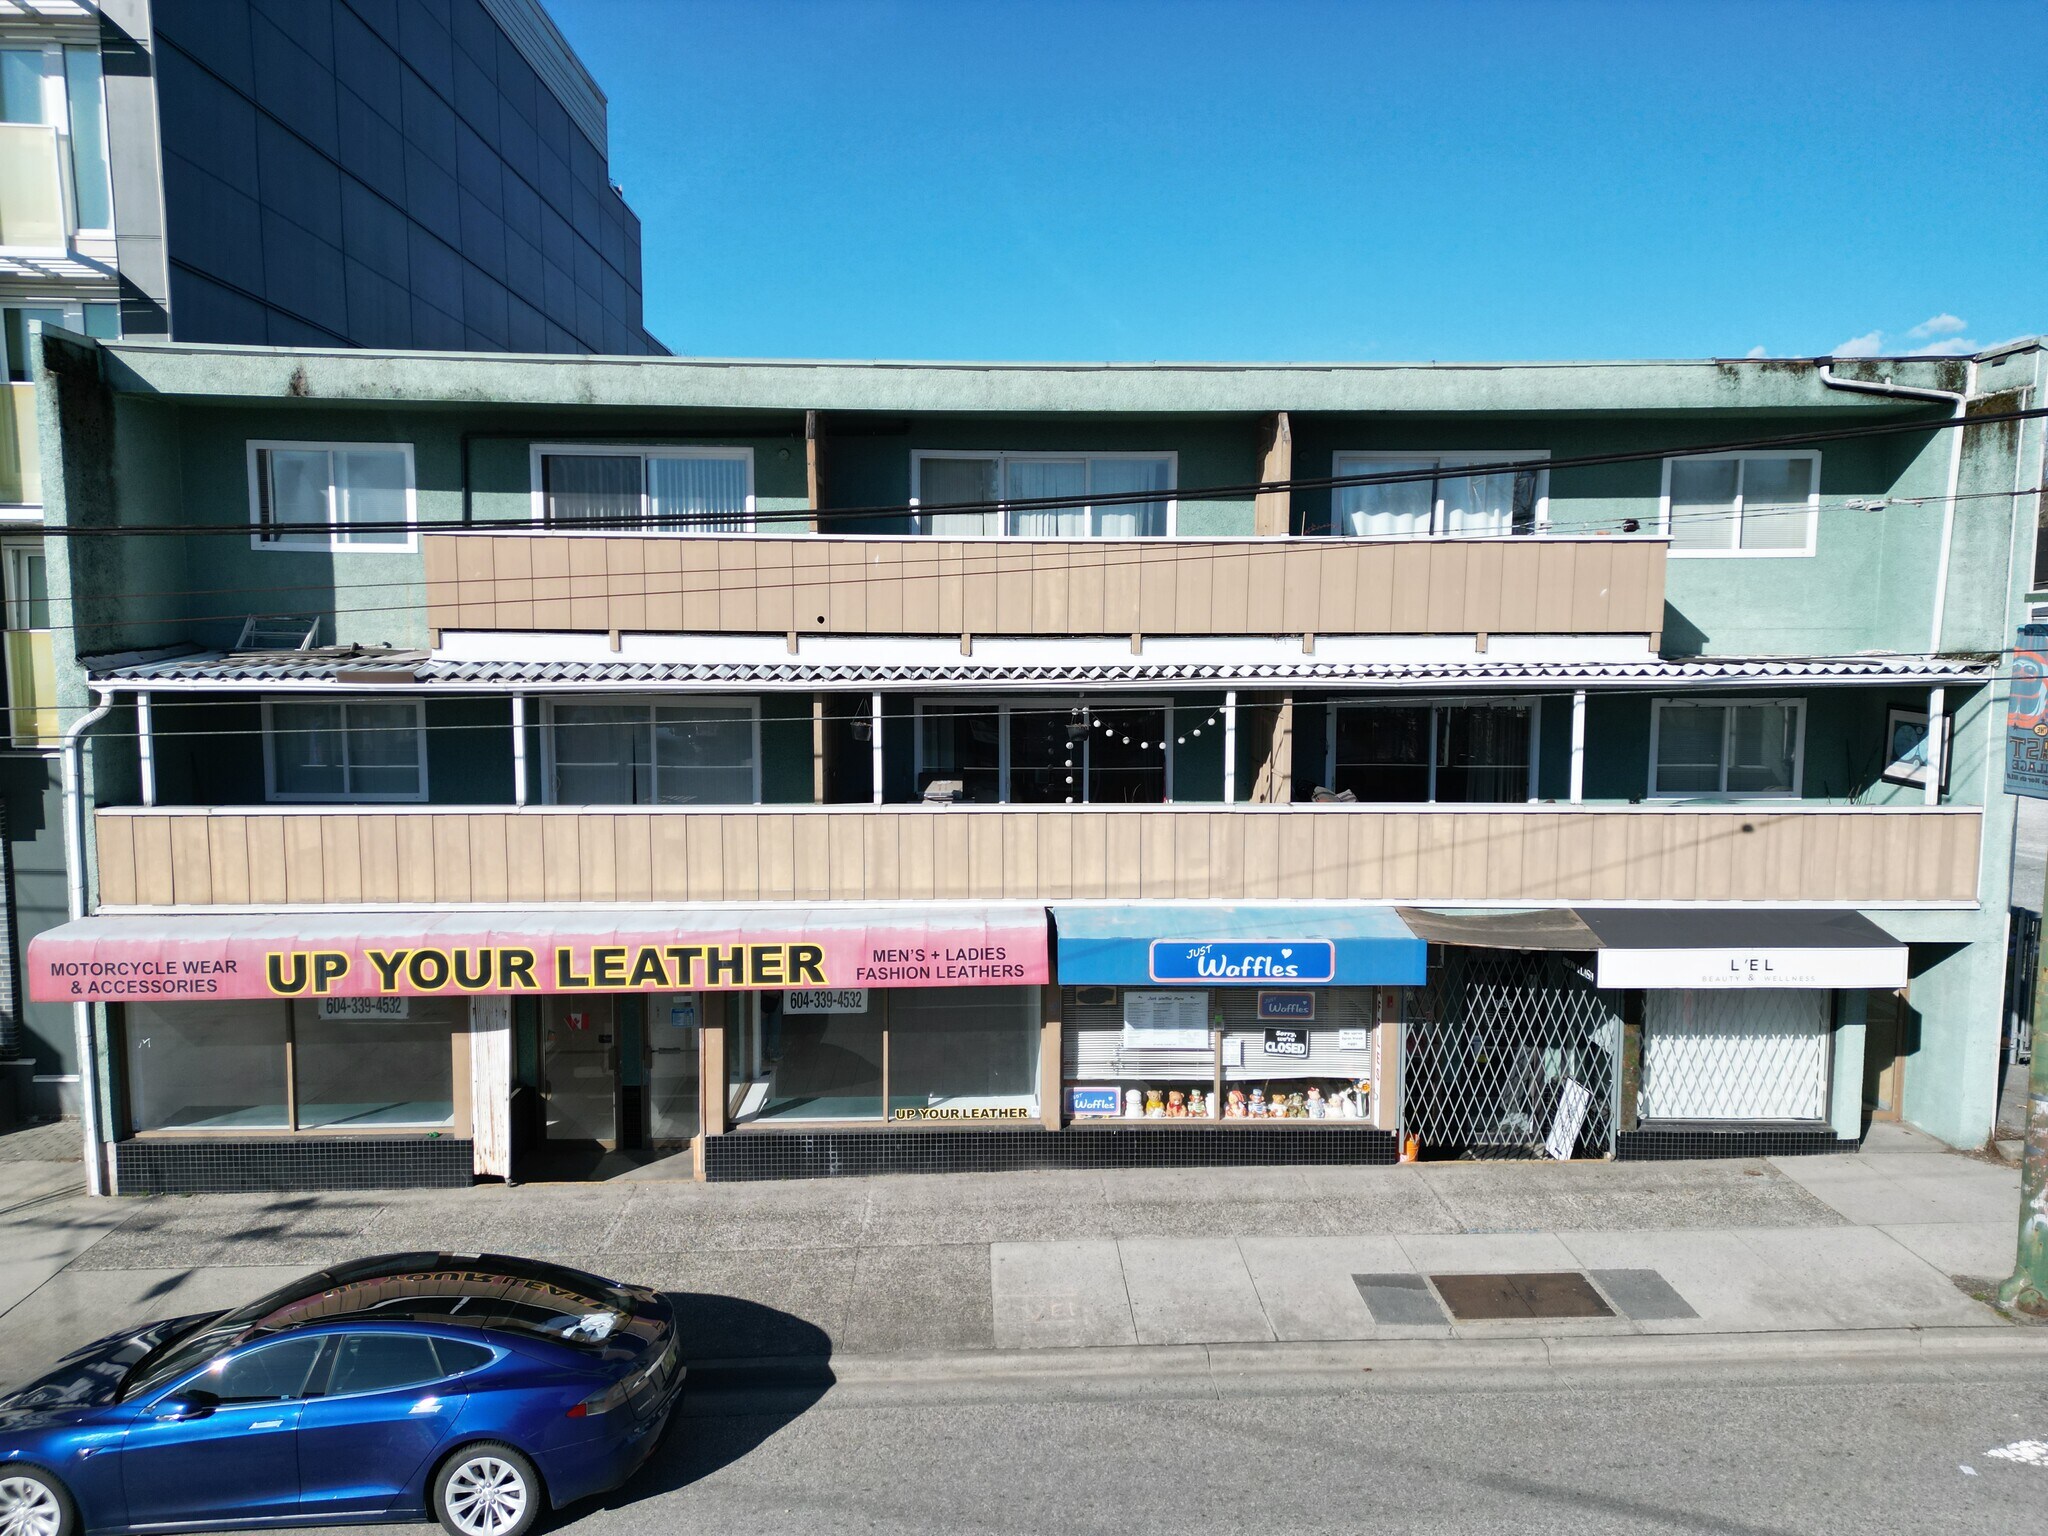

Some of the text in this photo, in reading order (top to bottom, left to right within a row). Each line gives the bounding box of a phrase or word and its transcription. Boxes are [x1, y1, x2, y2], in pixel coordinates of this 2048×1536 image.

[873, 947, 1006, 962] MEN'S + LADIES
[1186, 944, 1213, 960] JUST
[51, 960, 237, 976] MOTORCYCLE WEAR
[266, 942, 830, 996] UP YOUR LEATHER
[856, 964, 1025, 981] FASHION LEATHERS
[1197, 954, 1299, 977] Waffles
[1747, 973, 1754, 982] &
[70, 979, 218, 994] & ACCESSORIES
[326, 996, 402, 1014] 604-339-4532
[790, 991, 862, 1009] 604-339-4532
[1268, 1002, 1309, 1013] Waffles
[1275, 1030, 1297, 1038] Sorry,
[1265, 1041, 1305, 1054] CLOSED
[1075, 1099, 1115, 1109] Waffles
[895, 1107, 1029, 1120] UP YOUR LEATHER
